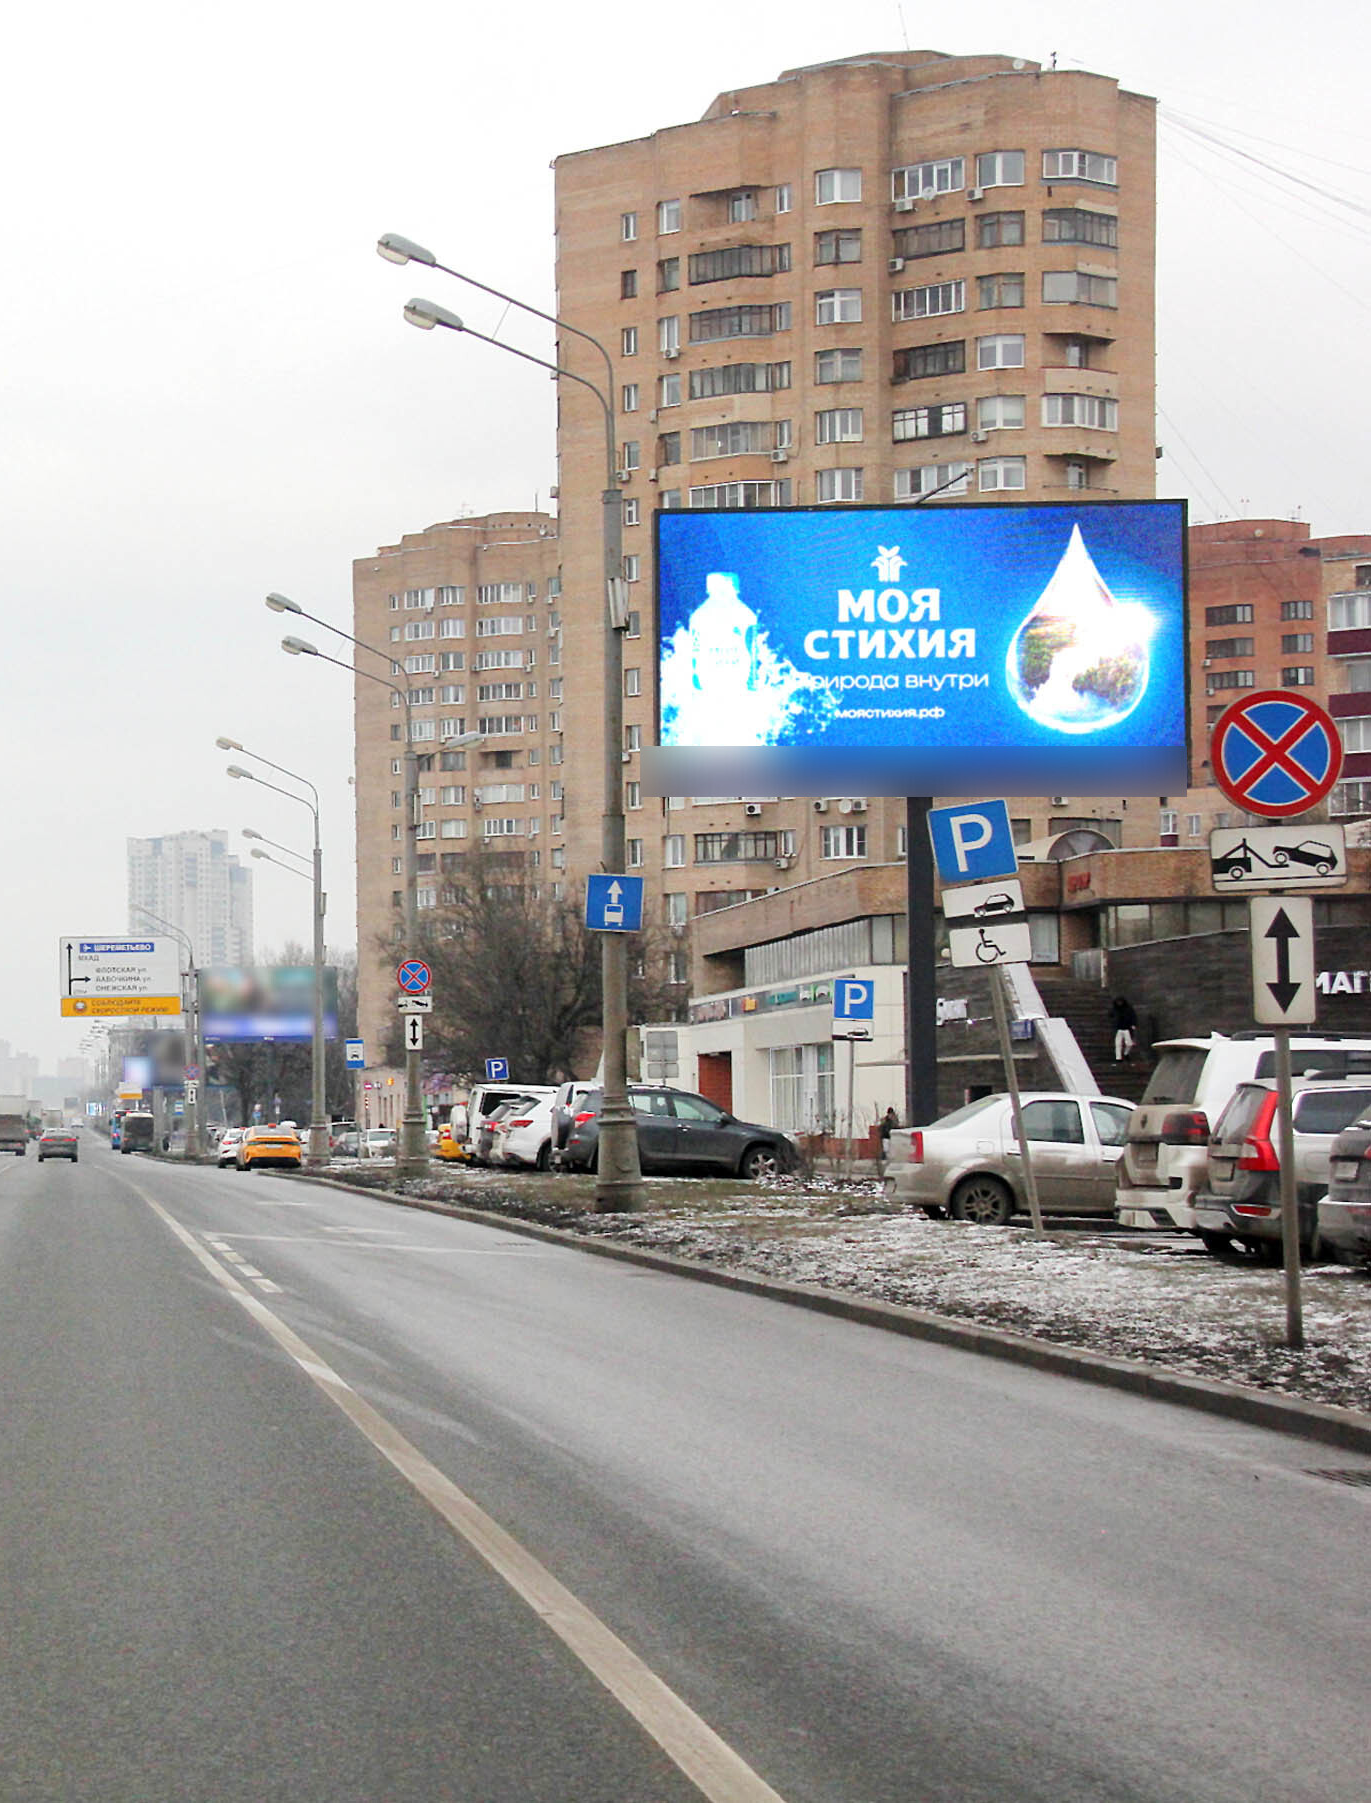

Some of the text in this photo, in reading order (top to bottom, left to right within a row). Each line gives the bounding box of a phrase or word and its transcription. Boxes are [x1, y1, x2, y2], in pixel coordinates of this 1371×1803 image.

[838, 588, 940, 623] МОЯ
[804, 628, 976, 660] СТИХИЯ
[797, 673, 989, 691] рирода внутри
[834, 707, 945, 719] моястихия.рф
[950, 814, 993, 872] P
[844, 983, 868, 1015] P
